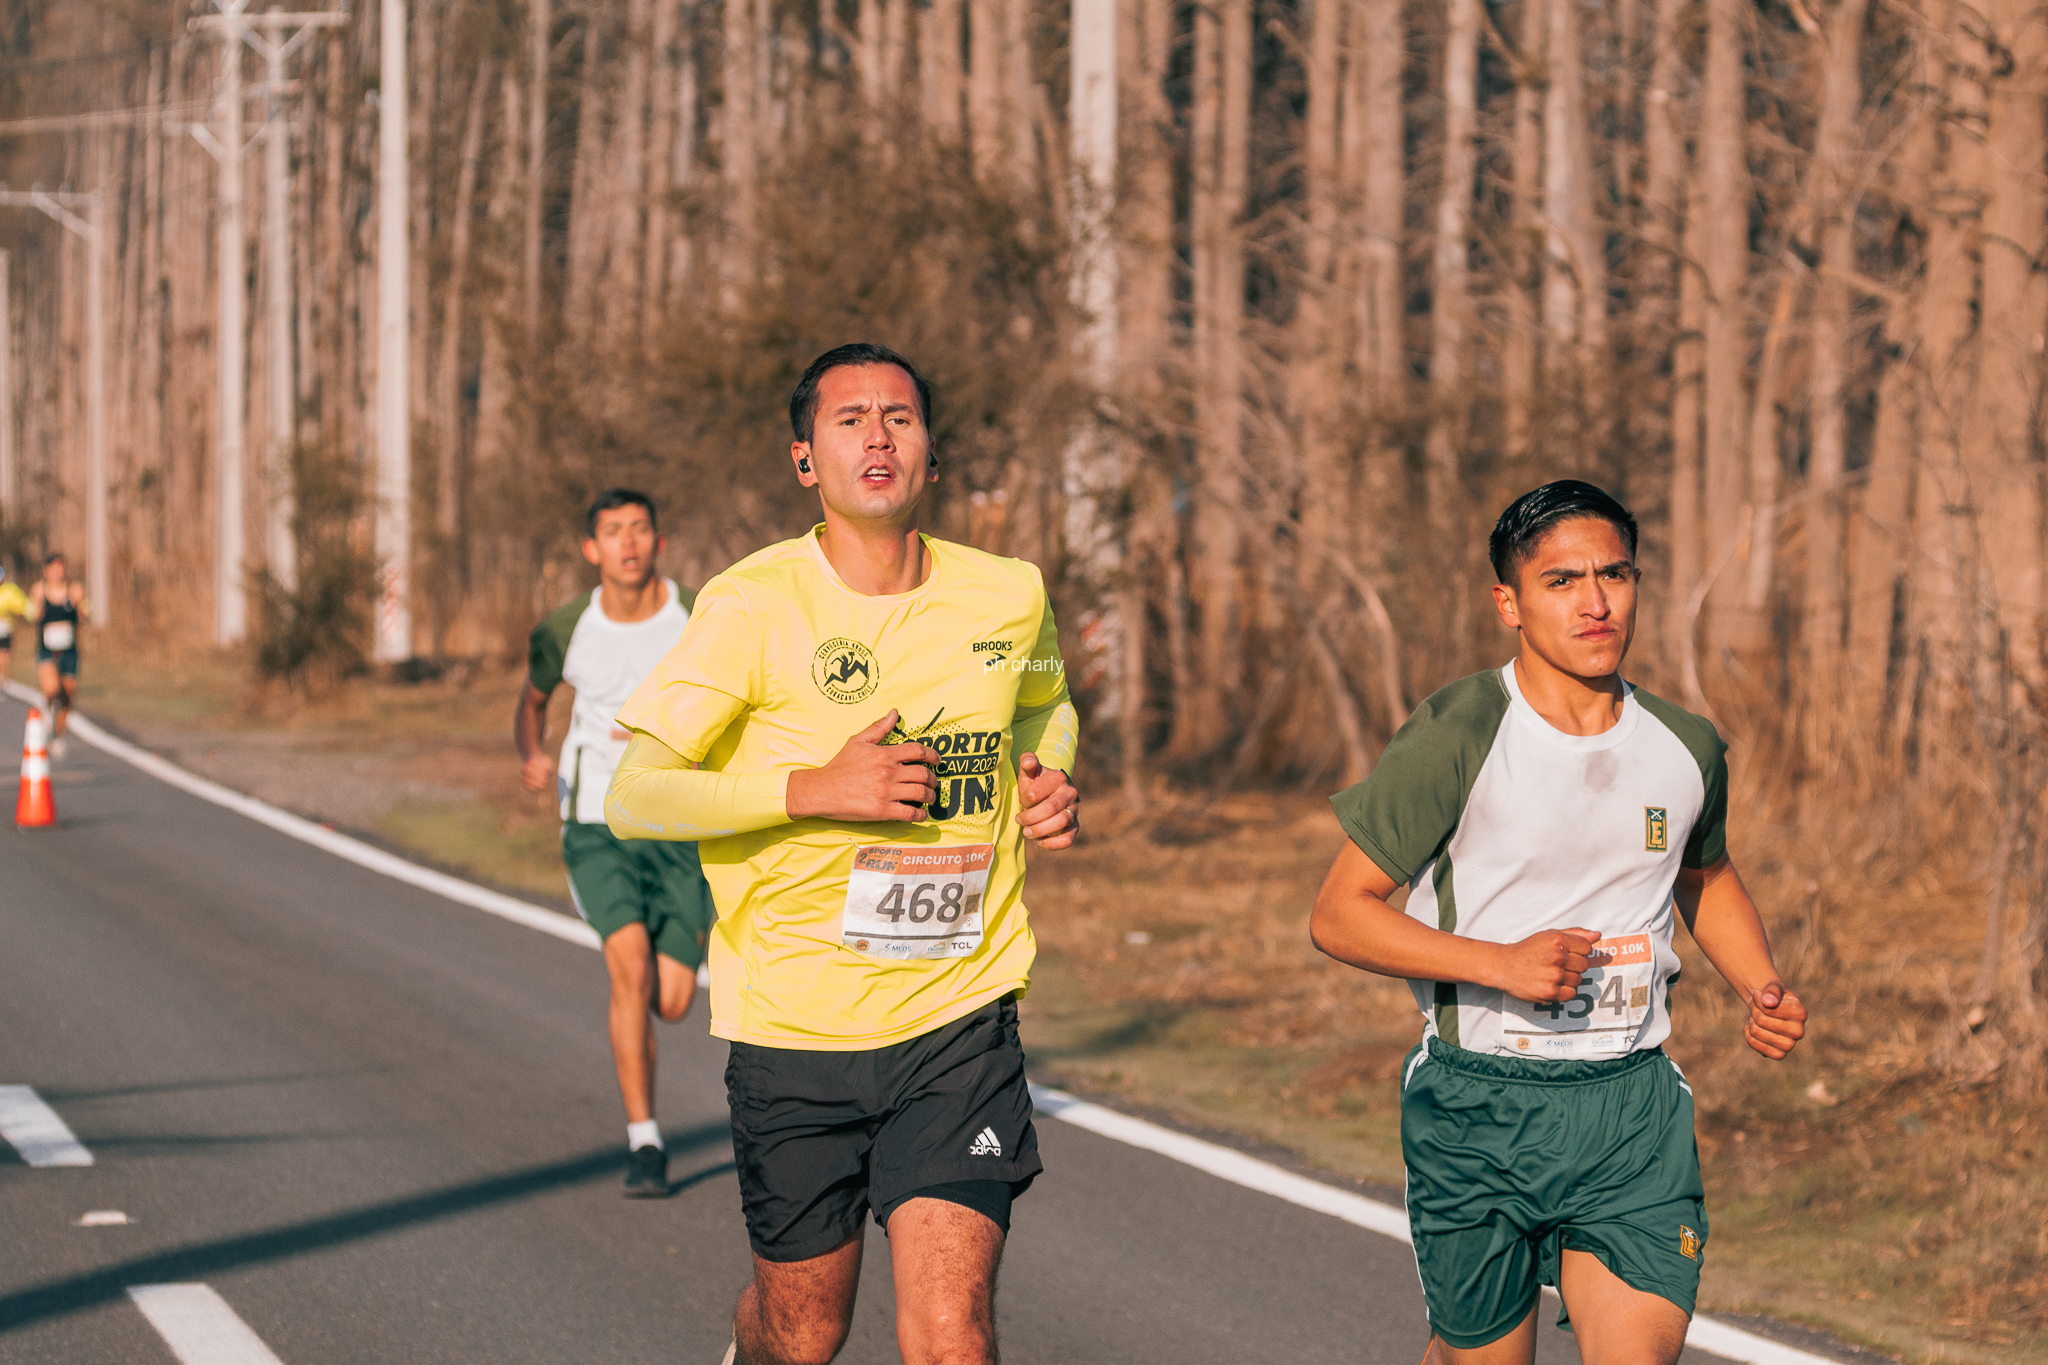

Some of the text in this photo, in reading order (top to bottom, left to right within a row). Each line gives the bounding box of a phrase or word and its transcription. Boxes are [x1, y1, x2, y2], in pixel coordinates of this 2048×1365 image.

[972, 640, 1013, 653] BROOKS
[903, 731, 1002, 758] PORTO
[971, 756, 997, 773] 2023
[1651, 820, 1663, 845] E
[868, 848, 903, 856] SPORTO
[859, 852, 868, 864] 2
[865, 859, 898, 871] RUN
[902, 855, 963, 866] CIRCUITO
[964, 852, 986, 864] 10K
[876, 882, 964, 924] 468
[951, 942, 973, 951] TCL
[1621, 942, 1645, 955] 10K
[1554, 1040, 1574, 1048] MEDS
[1622, 1035, 1637, 1044] TC
